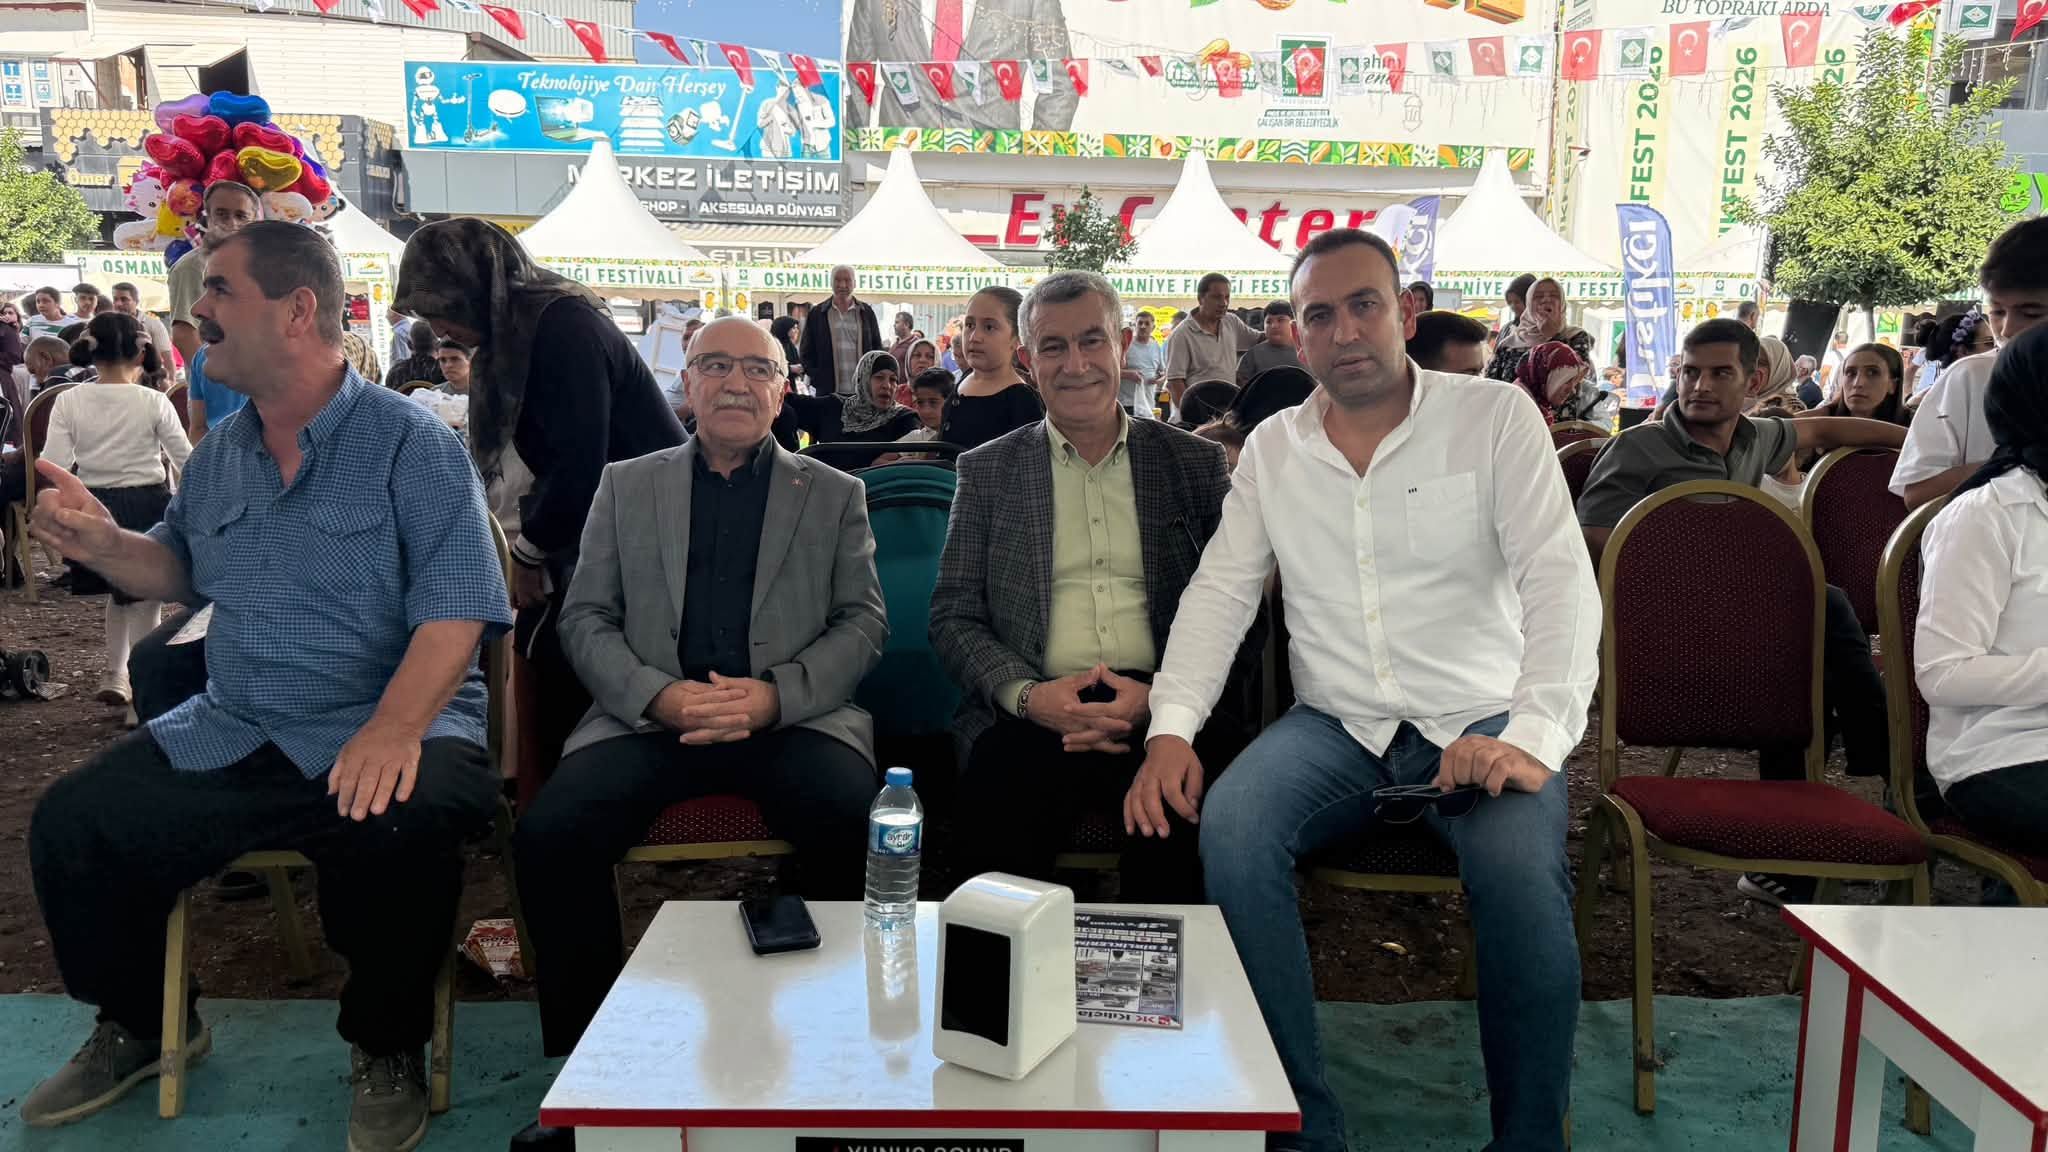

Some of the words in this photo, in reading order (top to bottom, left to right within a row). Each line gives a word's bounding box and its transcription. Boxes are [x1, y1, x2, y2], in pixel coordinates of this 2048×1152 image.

[1662, 0, 1690, 14] BU
[517, 71, 610, 97] Teknolojiye
[1729, 47, 1758, 121] 2026
[567, 164, 697, 188] MRKEZ
[706, 164, 841, 200] İLETİŞİM
[700, 202, 775, 216] AKSESUAR
[777, 202, 837, 217] DÜNYASI
[598, 265, 683, 286] FESTİVALİ
[859, 273, 919, 291] FISTIĞI
